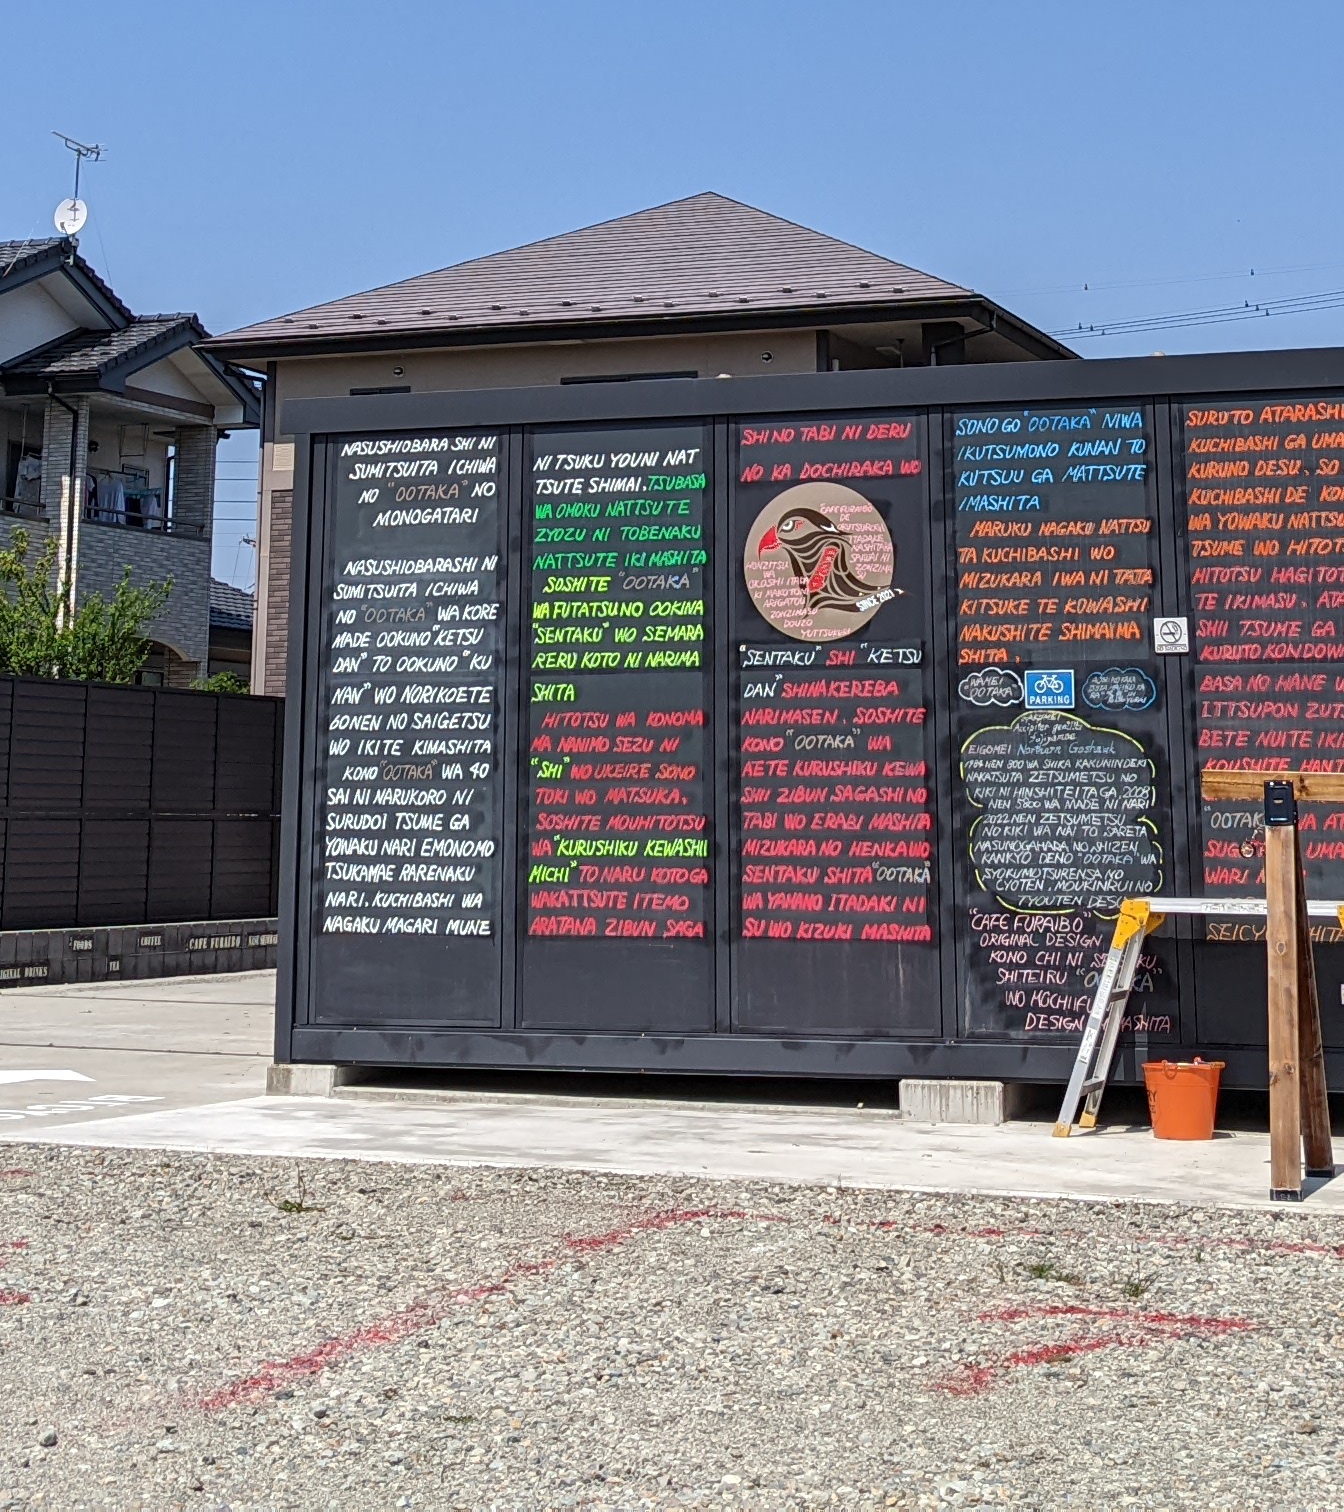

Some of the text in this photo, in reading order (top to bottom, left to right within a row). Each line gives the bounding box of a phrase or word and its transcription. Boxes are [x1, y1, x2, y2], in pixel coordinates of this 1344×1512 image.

[771, 429, 795, 443] NO
[800, 424, 836, 441] TABI
[842, 424, 862, 440] NI
[867, 423, 911, 439] DERU
[956, 419, 998, 435] SONO
[1001, 419, 1020, 432] GO
[451, 437, 476, 451] SHI
[478, 437, 496, 449] NI
[349, 457, 496, 479] SUMITSUITA ICHIWA
[958, 465, 1146, 487] KUTSUU GA MATTSUTE
[358, 489, 379, 503] NO
[471, 482, 495, 497] NO
[536, 500, 690, 519] WA OMOKU NATTSUTE
[959, 495, 1040, 511] IMASHITA
[372, 507, 479, 526] MONOGATARI
[1188, 514, 1212, 530] WA
[1218, 513, 1285, 530] YOWAKU
[534, 525, 700, 542] ZYOZU NI TOBENAKU
[1191, 540, 1245, 557] TSUME
[1254, 541, 1279, 556] WO
[343, 555, 498, 575] NASUSHIOBARASHI NI
[334, 580, 479, 599] SUMITSUITA ICHIWA
[332, 632, 371, 648] MADE
[376, 632, 431, 647] OOKUNO
[614, 627, 637, 642] WO
[642, 624, 704, 641] SEMARA
[532, 651, 699, 669] RERU KOTO NI NARIMA
[826, 650, 857, 666] SHI
[531, 684, 575, 702] SHITA
[1030, 696, 1069, 704] PARKING
[542, 712, 610, 728] HITOTSU
[616, 712, 636, 728] WA
[329, 739, 491, 755] WO IKITE KIMASHITA
[741, 736, 785, 752] KONO
[868, 736, 892, 751] WA
[1199, 730, 1251, 748] BETE
[1256, 730, 1314, 749] NUITE
[742, 760, 789, 777] AETE
[793, 760, 878, 776] KURUSHIKU
[988, 799, 1011, 809] NEN
[1045, 800, 1060, 809] WA
[1065, 799, 1099, 809] MADE
[1104, 800, 1118, 809] NI
[1122, 799, 1149, 809] NARI
[326, 813, 470, 830] SURUDOI TSUME GA
[325, 836, 377, 857] YOWAKU
[381, 839, 416, 856] NARI
[634, 892, 689, 910] ITEMO
[323, 916, 491, 935] NAGAKU MAGARI MUNE
[529, 916, 704, 938] ARATANA ZIBUN SAGA
[72, 939, 92, 951] FOODS
[189, 937, 207, 949] CAFE
[211, 936, 241, 948] FURAIBO
[980, 933, 1103, 947] ORIGINAL DESIGN
[109, 961, 119, 971] TEA
[996, 968, 1067, 984] SHITEIRU
